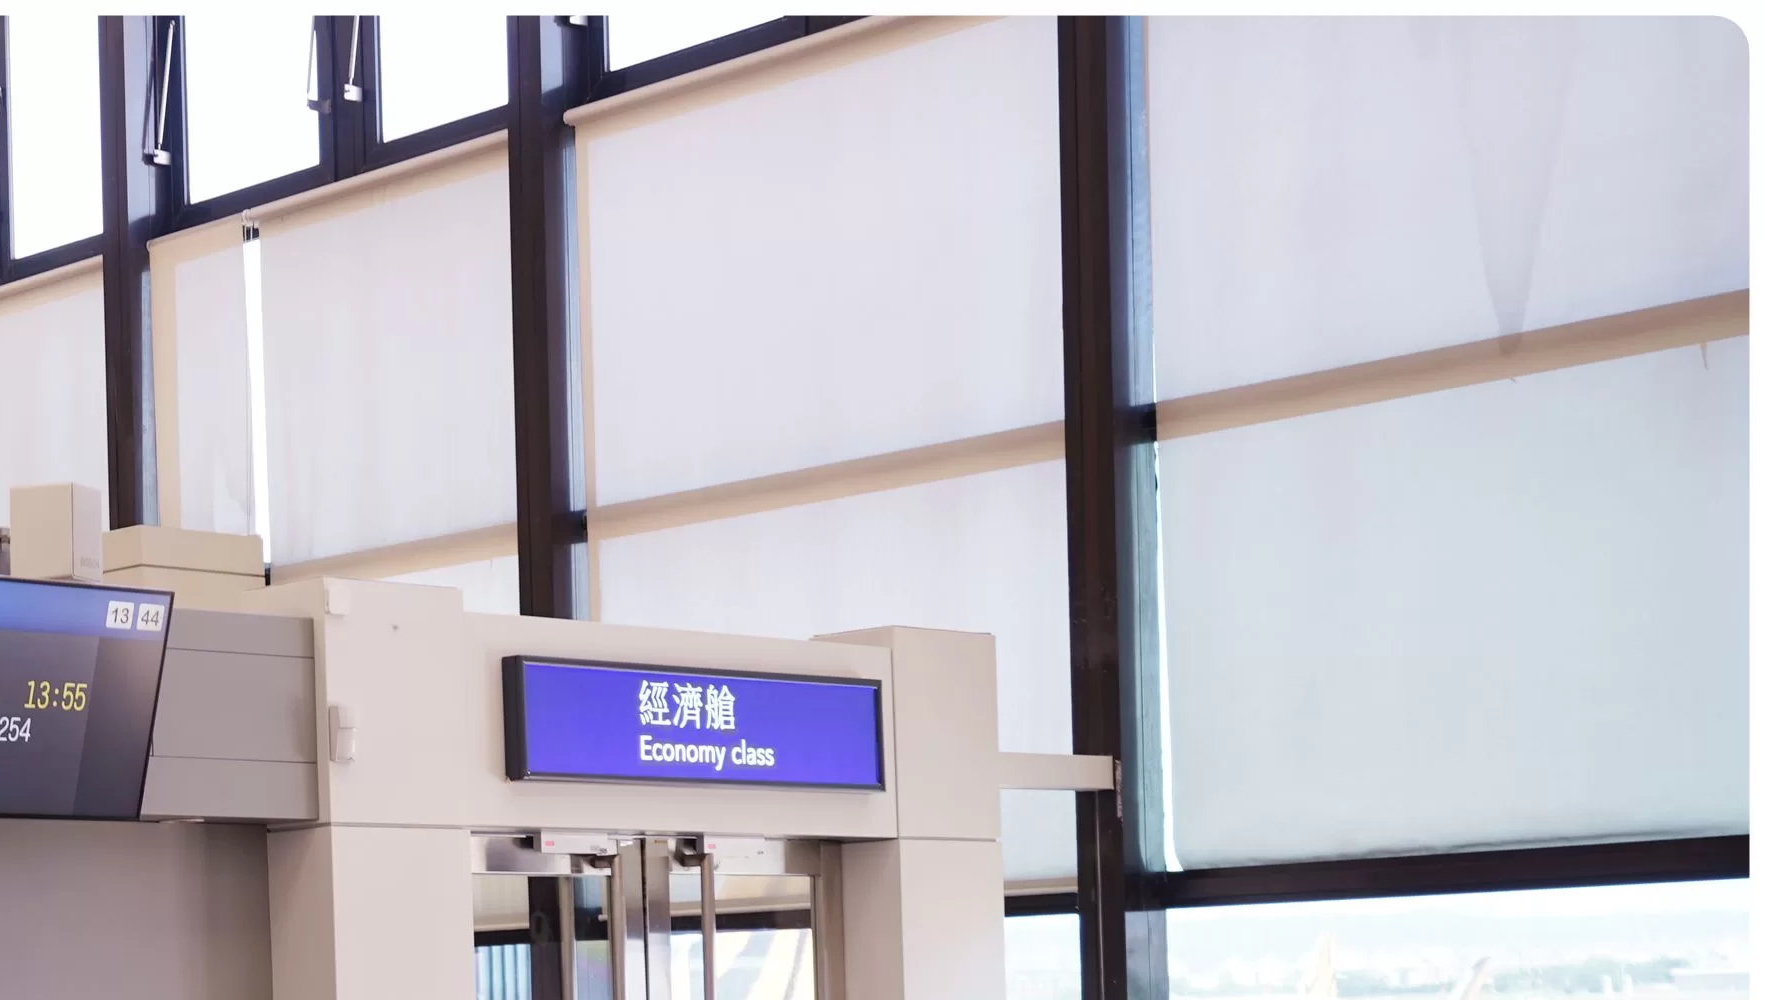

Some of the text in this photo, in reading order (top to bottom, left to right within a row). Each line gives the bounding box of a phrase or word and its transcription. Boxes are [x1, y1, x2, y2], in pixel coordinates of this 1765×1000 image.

[111, 606, 160, 626] 13 44
[24, 680, 87, 711] 13:55
[638, 679, 736, 730] 經濟艙
[639, 734, 775, 771] Economy class
